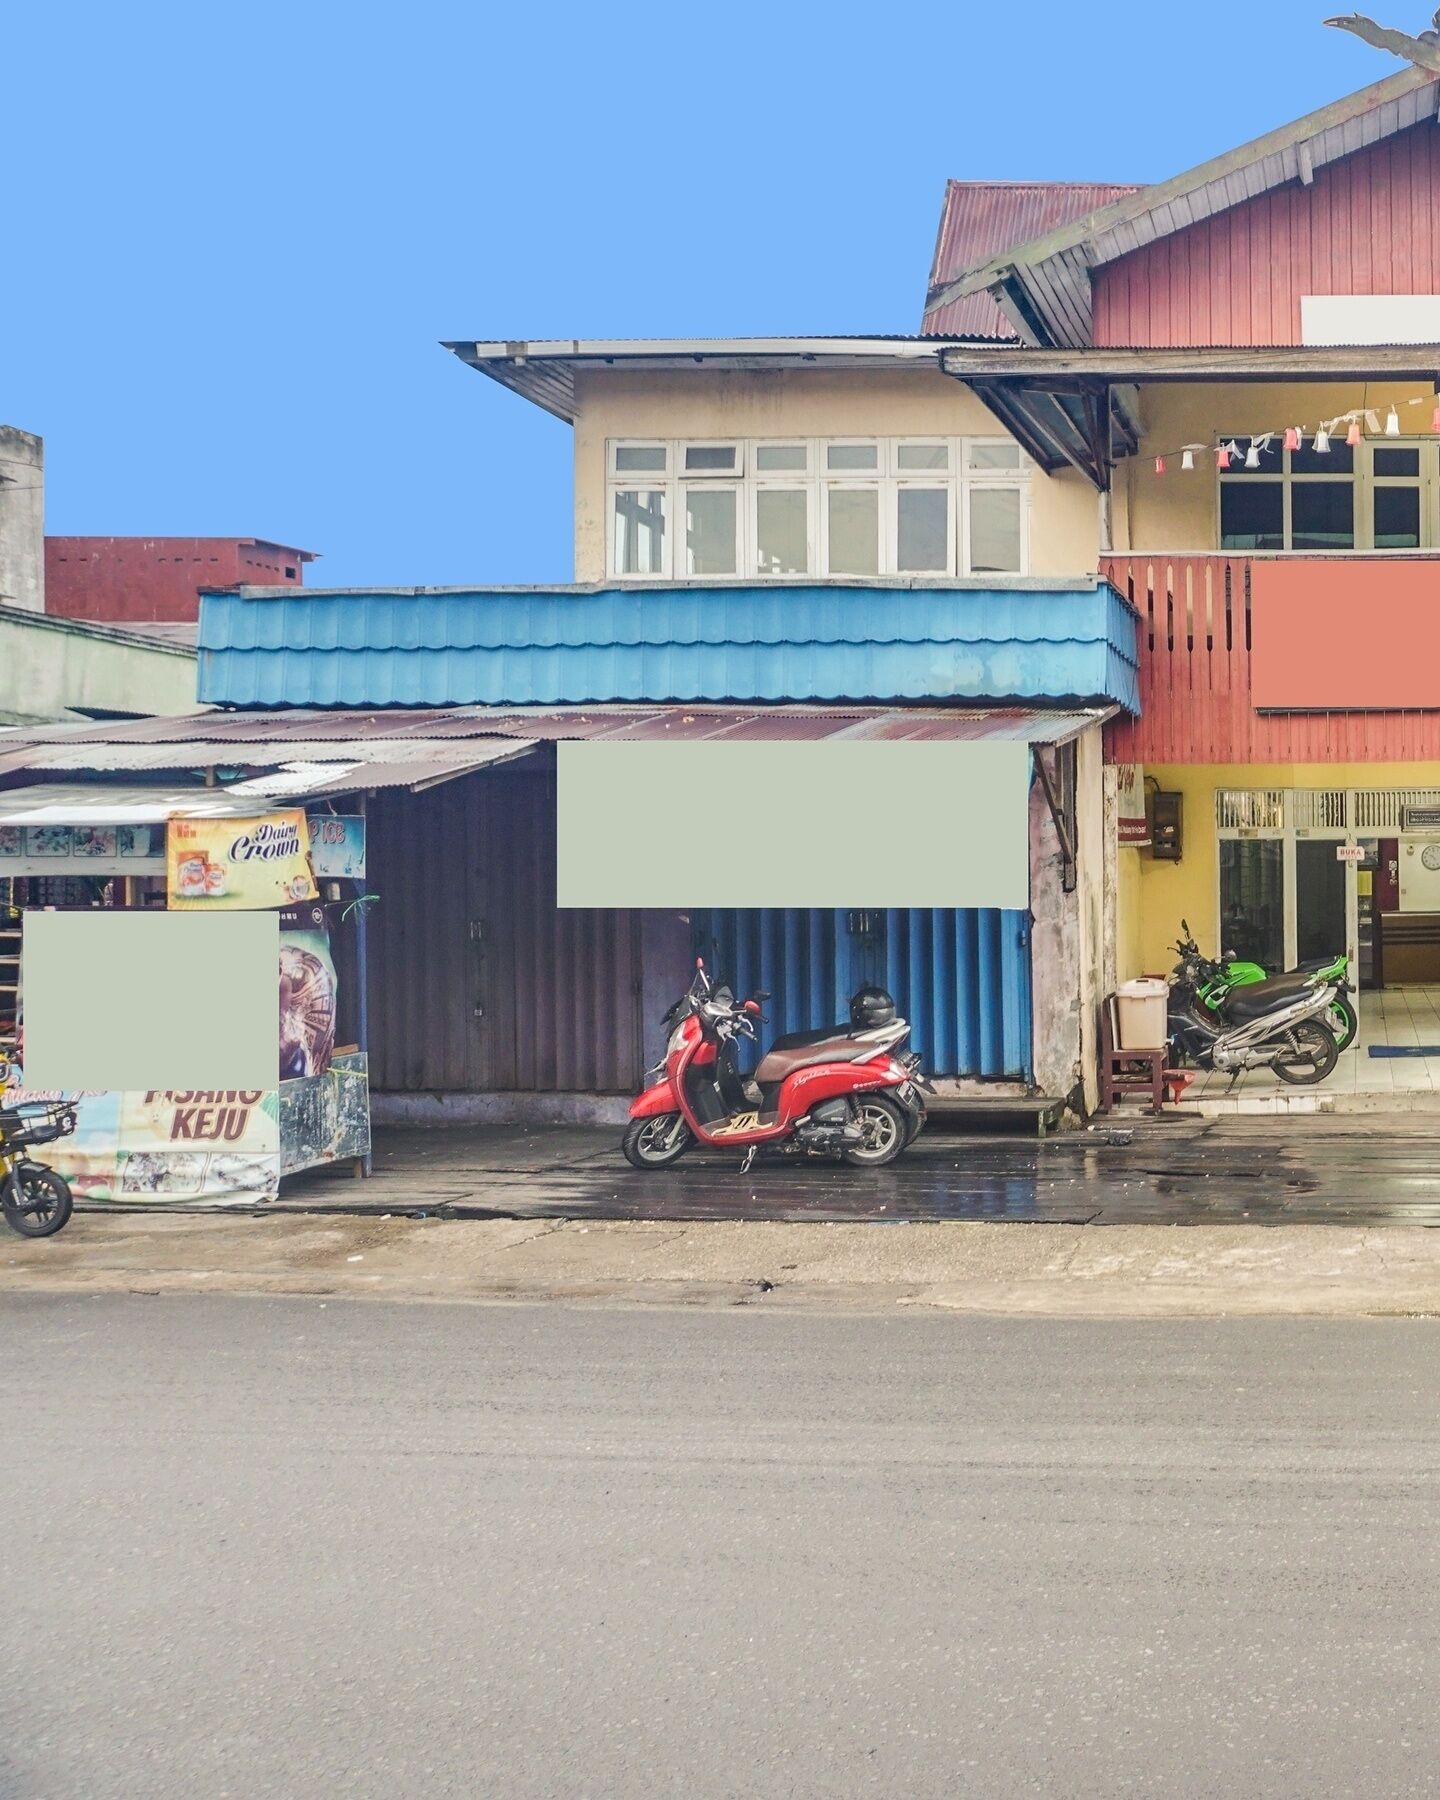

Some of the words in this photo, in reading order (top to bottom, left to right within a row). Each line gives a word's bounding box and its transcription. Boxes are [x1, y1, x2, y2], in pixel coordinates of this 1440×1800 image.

[256, 821, 298, 842] Dairy
[230, 836, 299, 861] Crown
[1340, 848, 1361, 856] BUKA
[170, 1107, 248, 1141] KEJU
